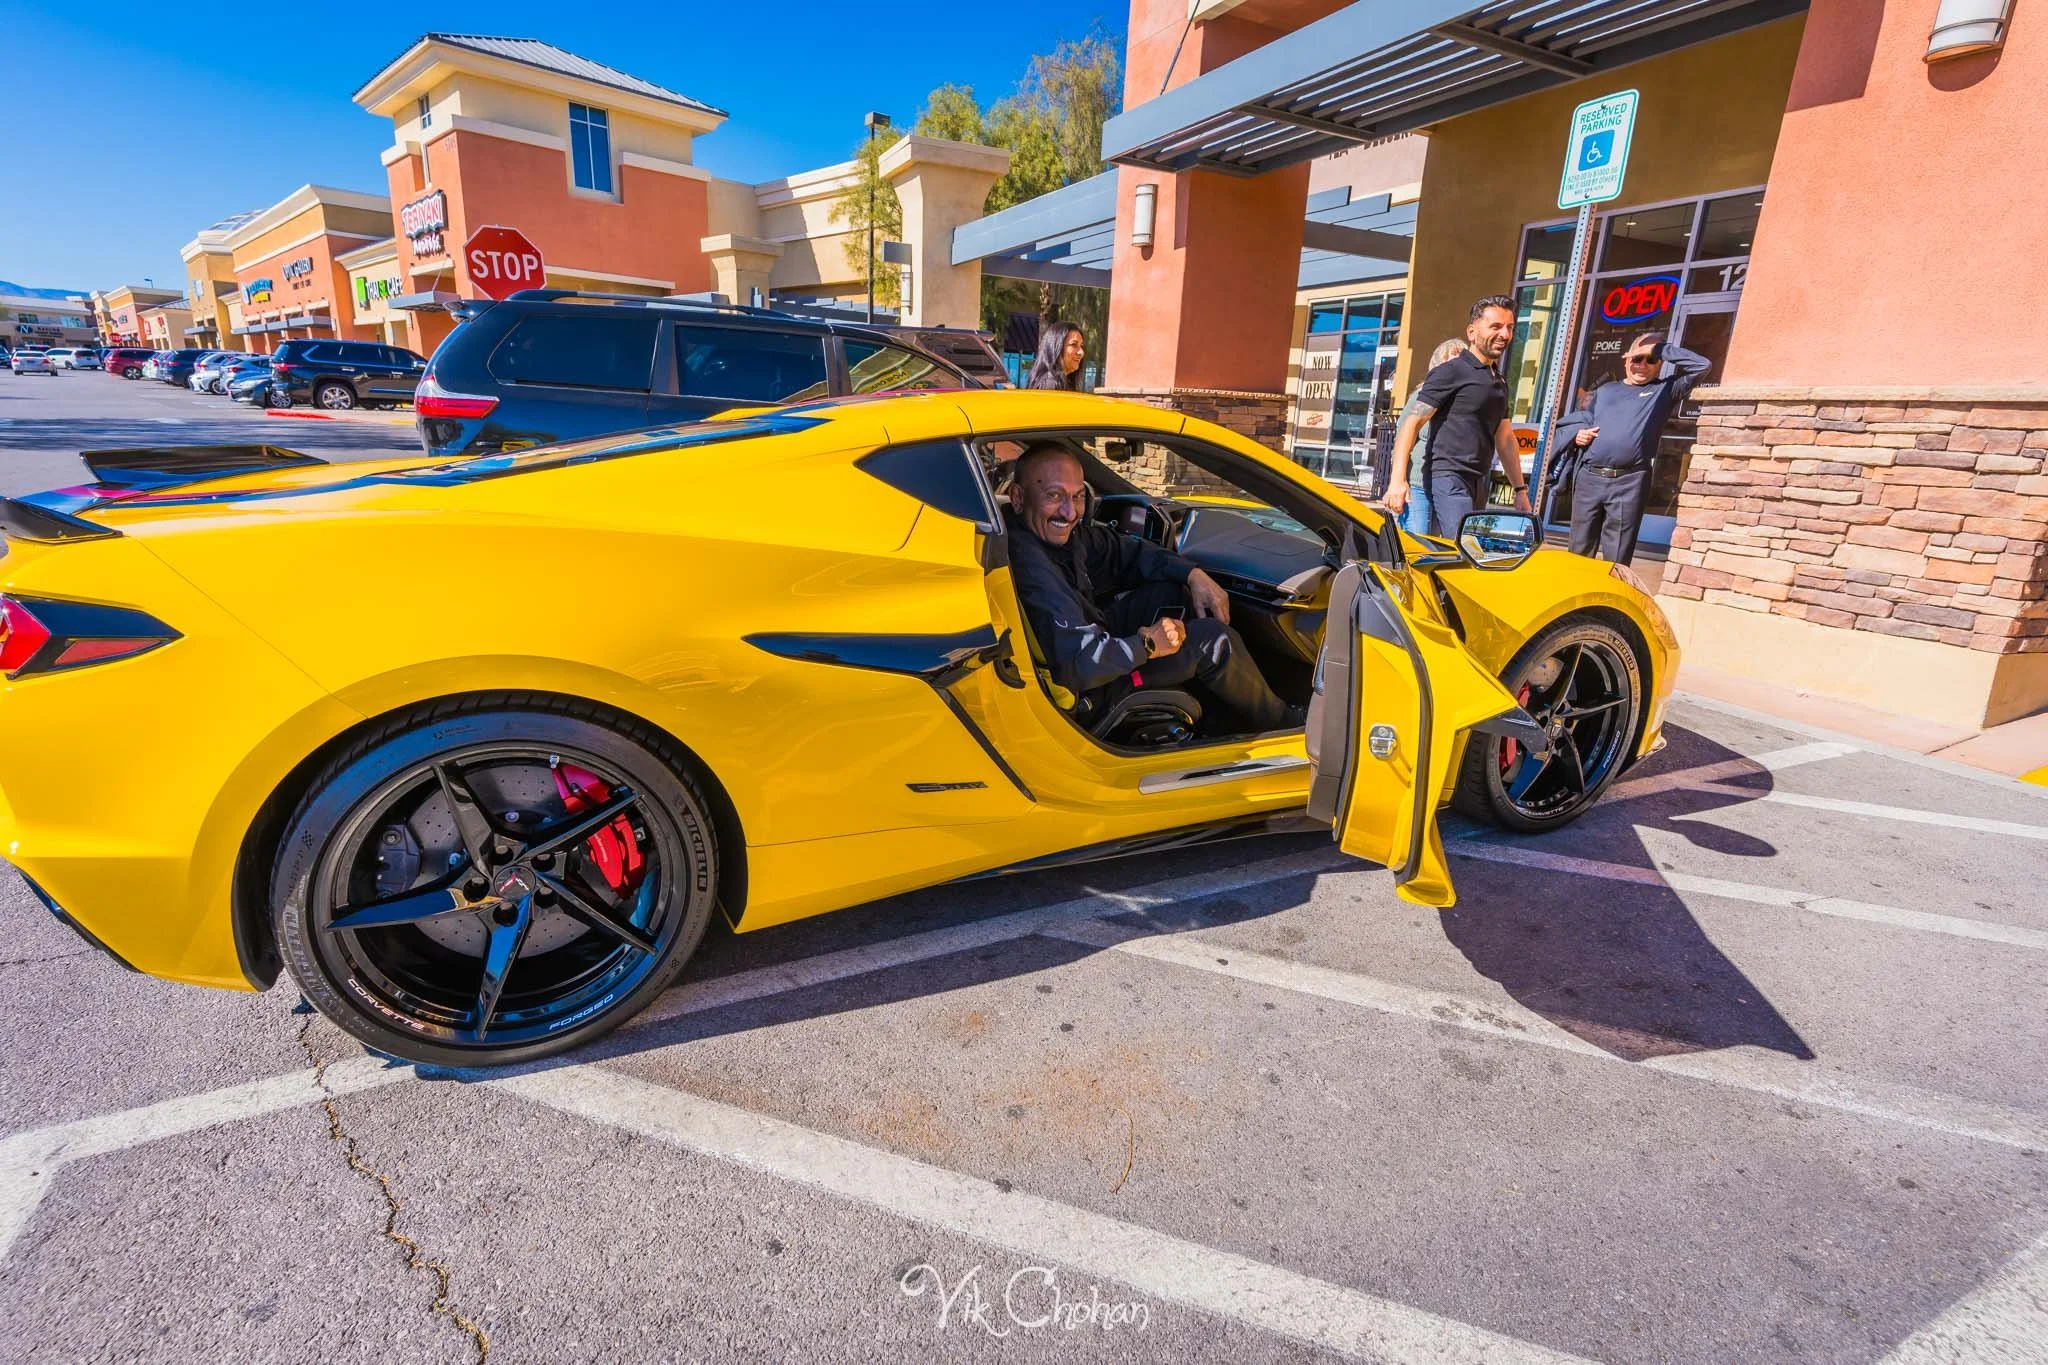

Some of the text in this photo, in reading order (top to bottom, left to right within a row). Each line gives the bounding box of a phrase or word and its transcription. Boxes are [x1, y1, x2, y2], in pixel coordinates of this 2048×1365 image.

[1580, 103, 1628, 124] RESERVED
[1580, 115, 1622, 134] PARKING
[403, 194, 443, 236] TERIYAKI
[470, 249, 539, 281] STOP
[1603, 283, 1677, 317] OPEN
[1595, 340, 1622, 351] POKE
[1311, 355, 1332, 371] NOW
[1305, 382, 1333, 400] OPEN
[684, 811, 708, 890] MICHELIN
[348, 978, 425, 1030] CORVETTE
[549, 993, 614, 1030] FORGED
